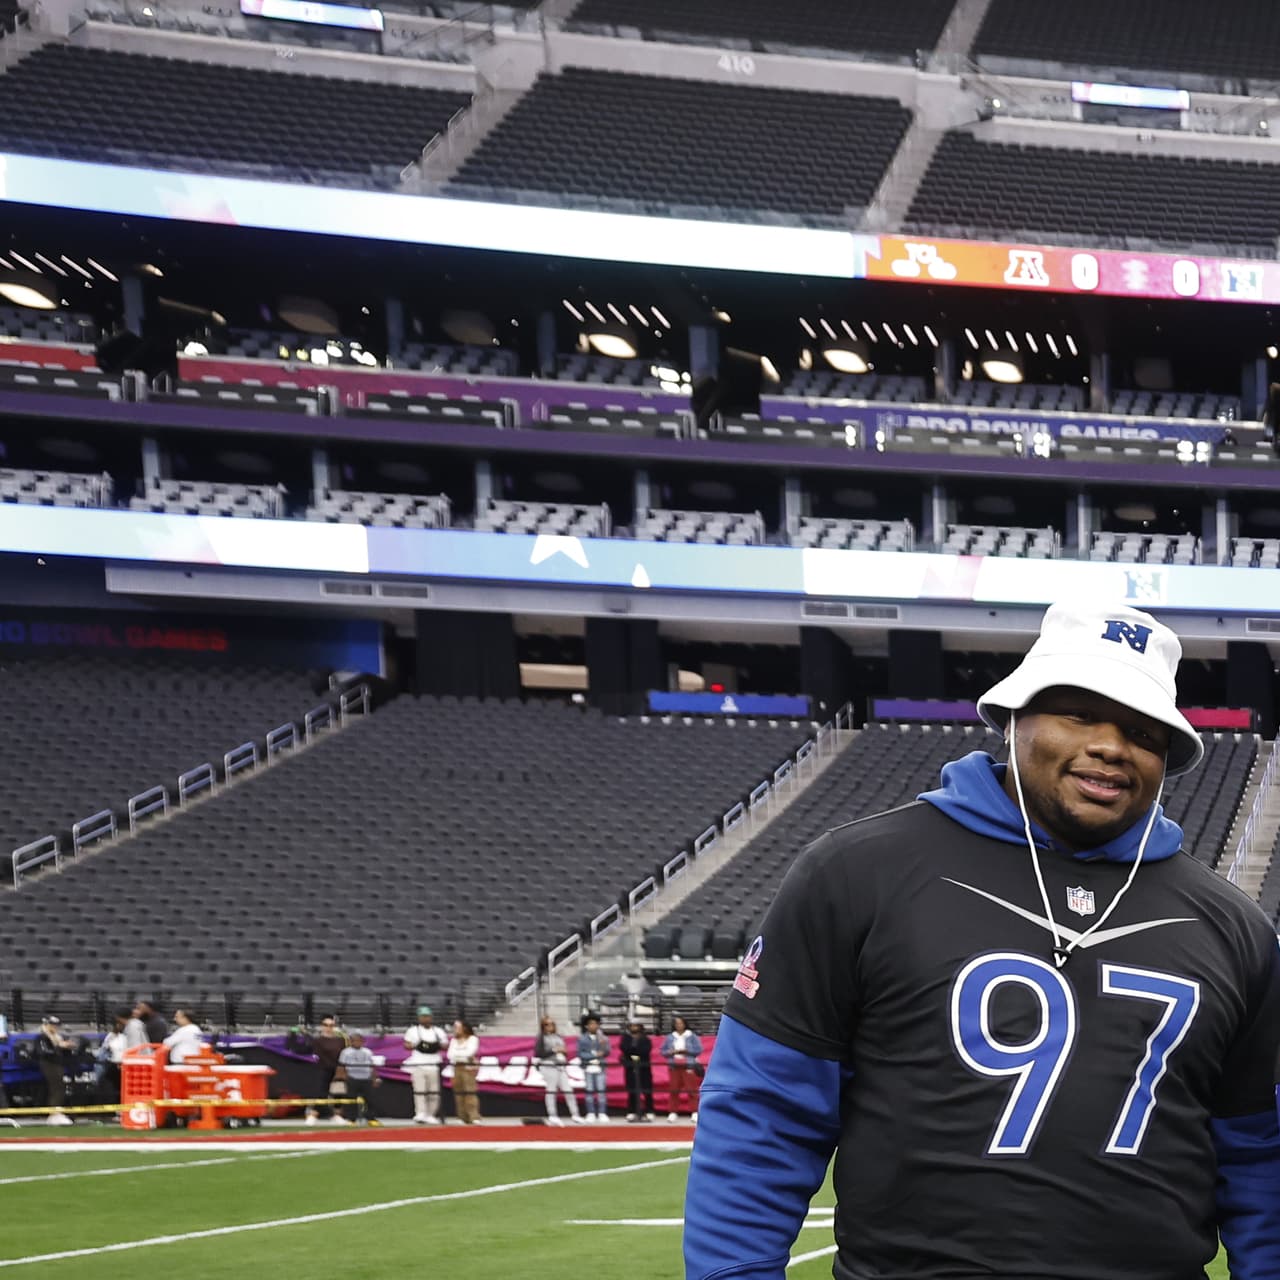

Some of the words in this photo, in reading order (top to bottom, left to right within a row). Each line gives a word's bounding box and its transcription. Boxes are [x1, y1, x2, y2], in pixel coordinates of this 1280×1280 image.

[718, 54, 756, 77] 410
[1071, 253, 1099, 291] 0
[1172, 259, 1200, 297] 0
[951, 952, 1200, 1155] 97
